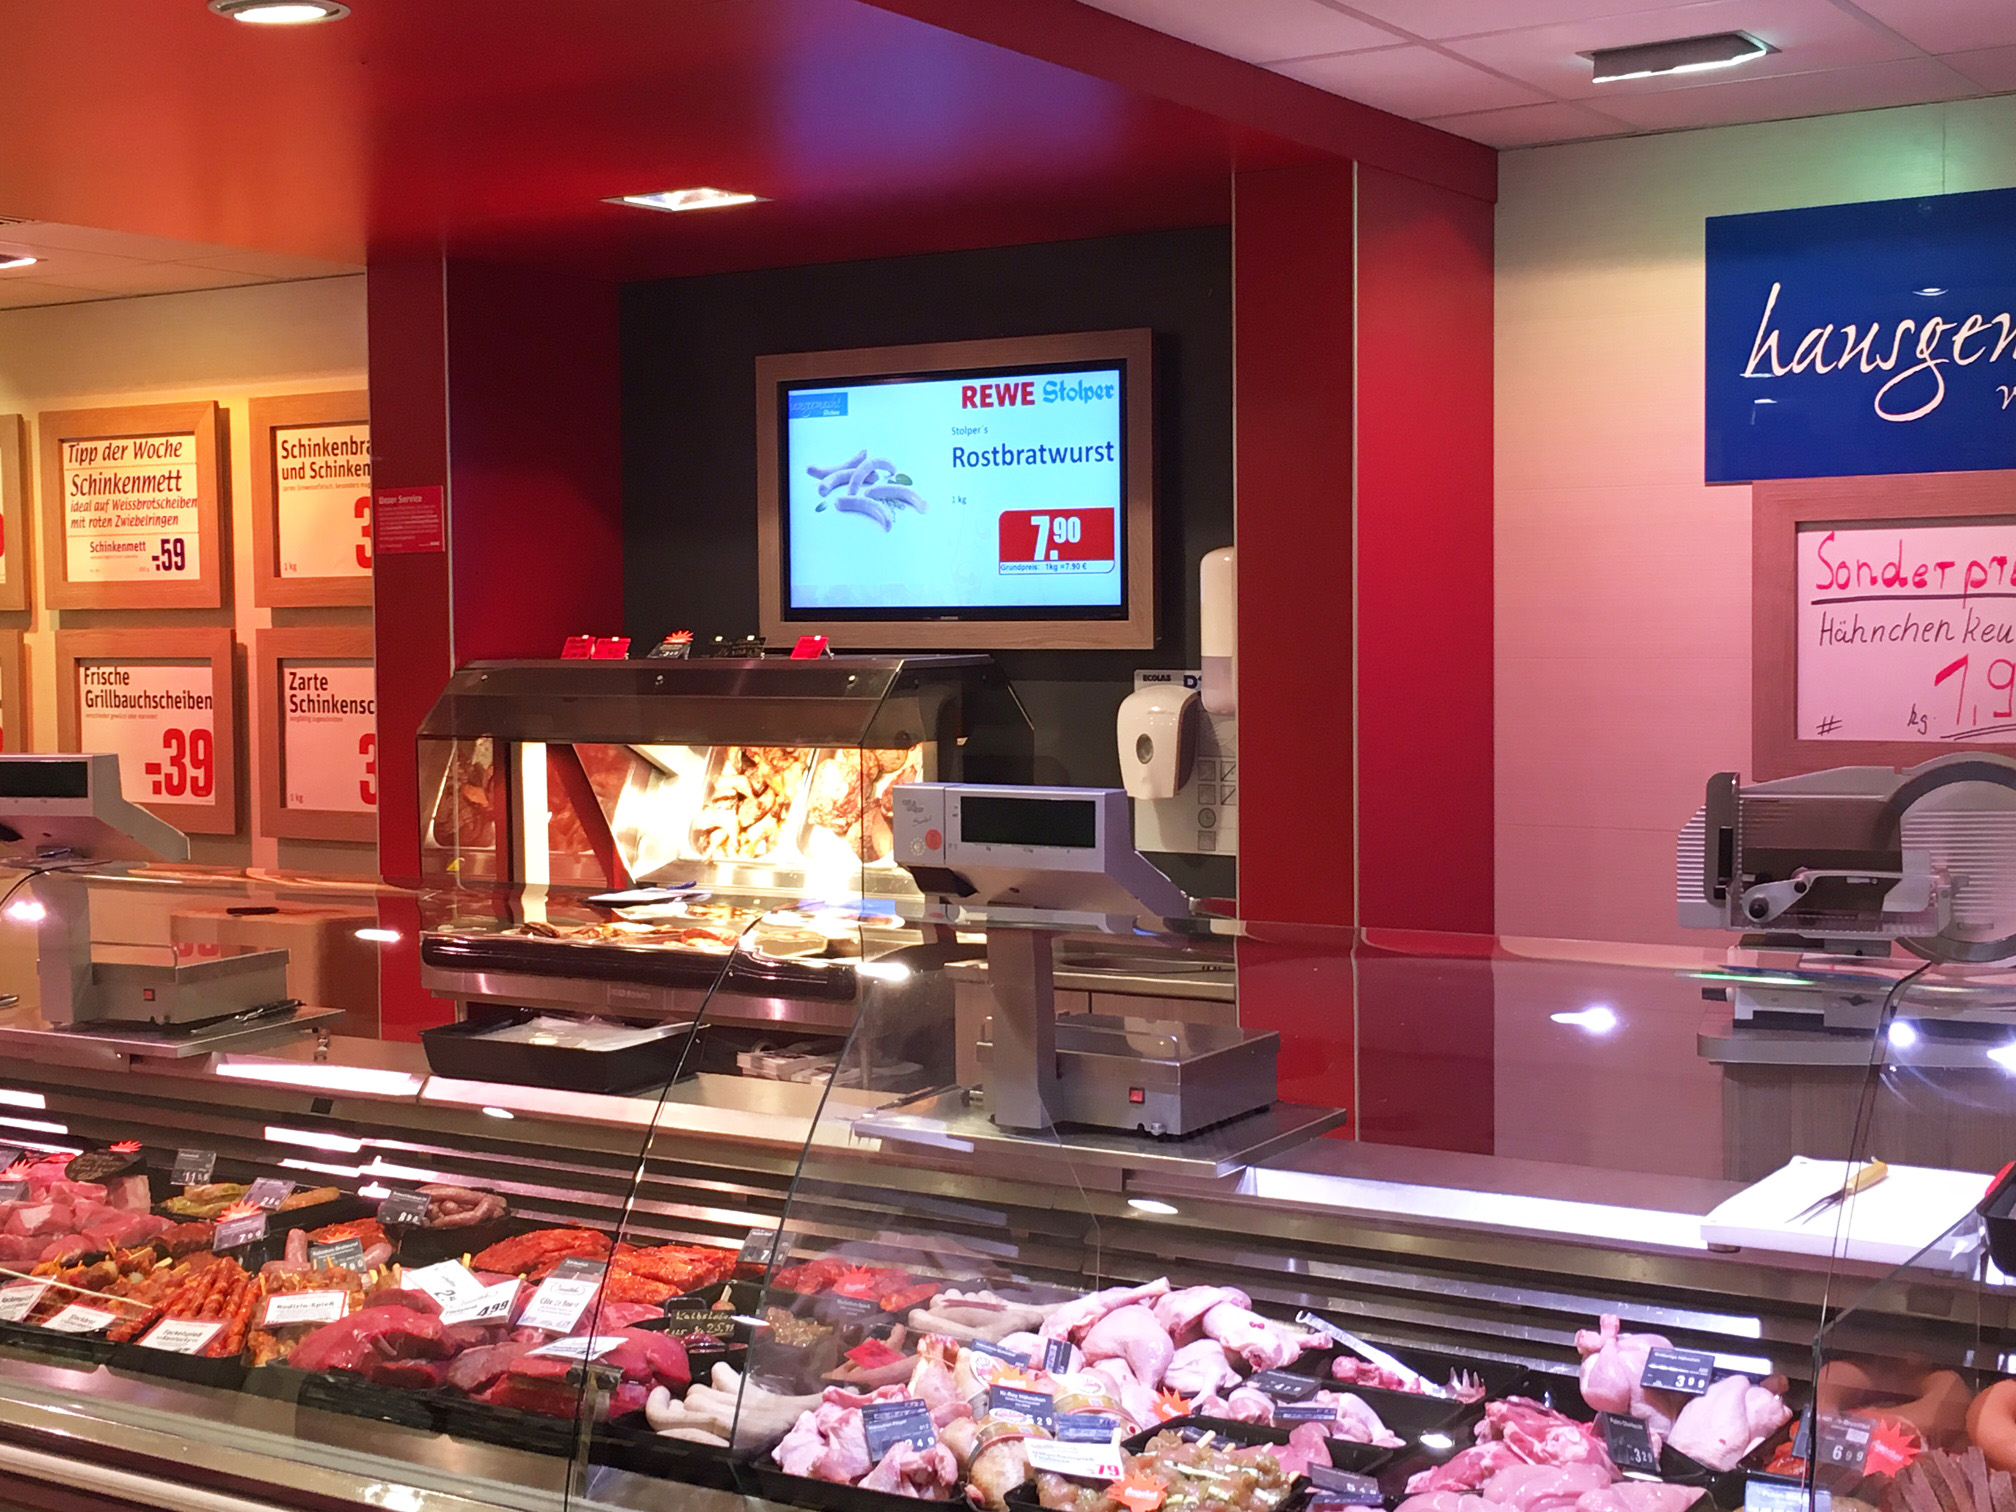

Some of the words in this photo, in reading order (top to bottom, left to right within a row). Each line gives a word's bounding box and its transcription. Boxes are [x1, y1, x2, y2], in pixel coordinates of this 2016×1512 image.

[961, 381, 1035, 409] REWE
[1042, 379, 1115, 404] Stolper
[68, 443, 98, 466] Tipp
[102, 442, 128, 461] der
[133, 439, 182, 460] Woche
[952, 441, 1115, 468] Rostbratwurst
[282, 462, 305, 480] und
[70, 469, 182, 497] Schinkenmett
[94, 499, 110, 513] auf
[112, 495, 198, 512] Weissbrotscheiben
[957, 496, 967, 505] kg
[70, 517, 86, 529] mit
[88, 516, 112, 529] roten
[115, 512, 179, 528] Zwiebelringen
[90, 540, 147, 553] Schinkenmett
[999, 563, 1040, 571] Grundpreis:
[84, 666, 130, 686] Frische
[289, 671, 328, 691] Zarte
[85, 689, 213, 709] Grillbauchscheiben
[289, 693, 375, 714] Schinkensc
